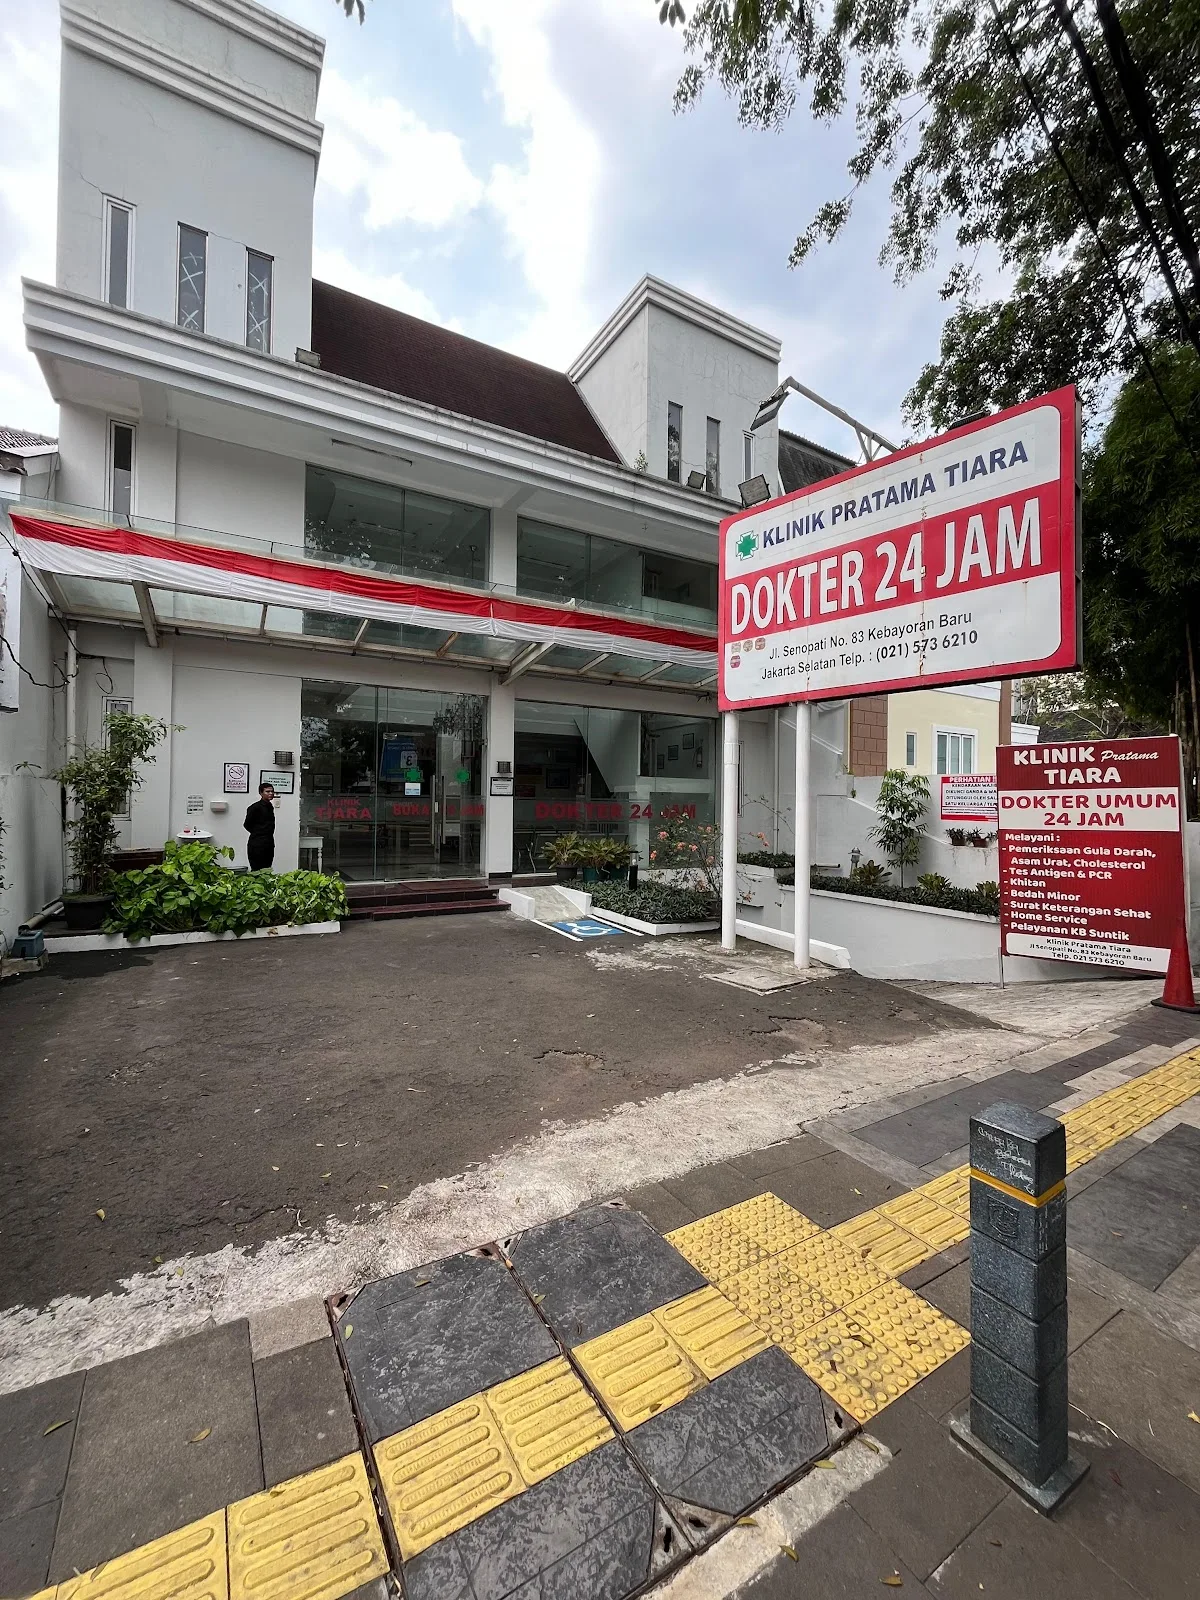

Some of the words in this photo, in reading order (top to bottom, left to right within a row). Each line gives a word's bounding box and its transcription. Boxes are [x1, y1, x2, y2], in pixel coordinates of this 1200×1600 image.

[763, 511, 825, 549] KLINIK
[831, 472, 936, 526] PRATAMA
[944, 441, 1028, 488] TIARA
[731, 550, 864, 635] DOKTER
[874, 532, 925, 602] 24
[936, 498, 1041, 589] JAM
[769, 647, 780, 660] Jl.
[783, 638, 827, 657] Senopati
[830, 632, 848, 648] No.
[851, 630, 865, 644] 83
[868, 619, 934, 641] Kebayoran
[939, 612, 972, 629] Baru
[762, 664, 796, 680] Jakarta
[798, 656, 836, 673] Selatan
[839, 652, 865, 668] Telp.
[876, 643, 909, 662] (021)
[912, 637, 938, 655] 573
[942, 630, 978, 649] 6210
[1013, 747, 1095, 766] KLINIK
[1100, 750, 1159, 763] Pratama
[1044, 766, 1121, 785] TIARA
[327, 798, 361, 807] KLINIK
[1001, 795, 1090, 809] DOKTER
[1096, 793, 1177, 809] UMUM
[315, 807, 372, 820] TIARA
[535, 803, 622, 819] DOKTER
[630, 804, 653, 819] 24
[660, 803, 697, 819] JAM
[1044, 812, 1071, 826] 24
[1077, 812, 1124, 827] JAM
[1005, 833, 1054, 843] Melayani
[1008, 845, 1081, 855] Pemeriksaan
[1083, 846, 1111, 856] Gula
[1113, 847, 1156, 858] Darah,
[1011, 857, 1041, 866] Asam
[1043, 858, 1071, 868] Urat,
[1073, 859, 1146, 870] Cholesterol
[1009, 867, 1028, 876] Tes
[1030, 868, 1075, 879] Antigen
[1077, 870, 1087, 879] &
[1088, 871, 1112, 880] PCR
[1010, 878, 1046, 888] Khitan
[1010, 889, 1044, 899] Bedah
[1047, 890, 1081, 901] Minor
[1010, 900, 1040, 910] Surat
[1042, 902, 1111, 916] Keterangan
[1113, 908, 1152, 919] Sehat
[1010, 911, 1042, 921] Home
[1044, 913, 1088, 925] Service
[1010, 921, 1068, 934] Pelayanan
[1070, 927, 1087, 937] KB
[1089, 929, 1130, 941] Suntik
[1035, 944, 1066, 954] Senopati
[1090, 950, 1132, 960] Kebayoran
[1046, 938, 1069, 947] Klinik
[1071, 940, 1107, 950] Pratama
[1109, 945, 1131, 953] Tiara
[1052, 951, 1072, 961] Telp.
[1073, 953, 1088, 962] 021
[1088, 955, 1103, 964] 573
[1104, 957, 1125, 966] 6210
